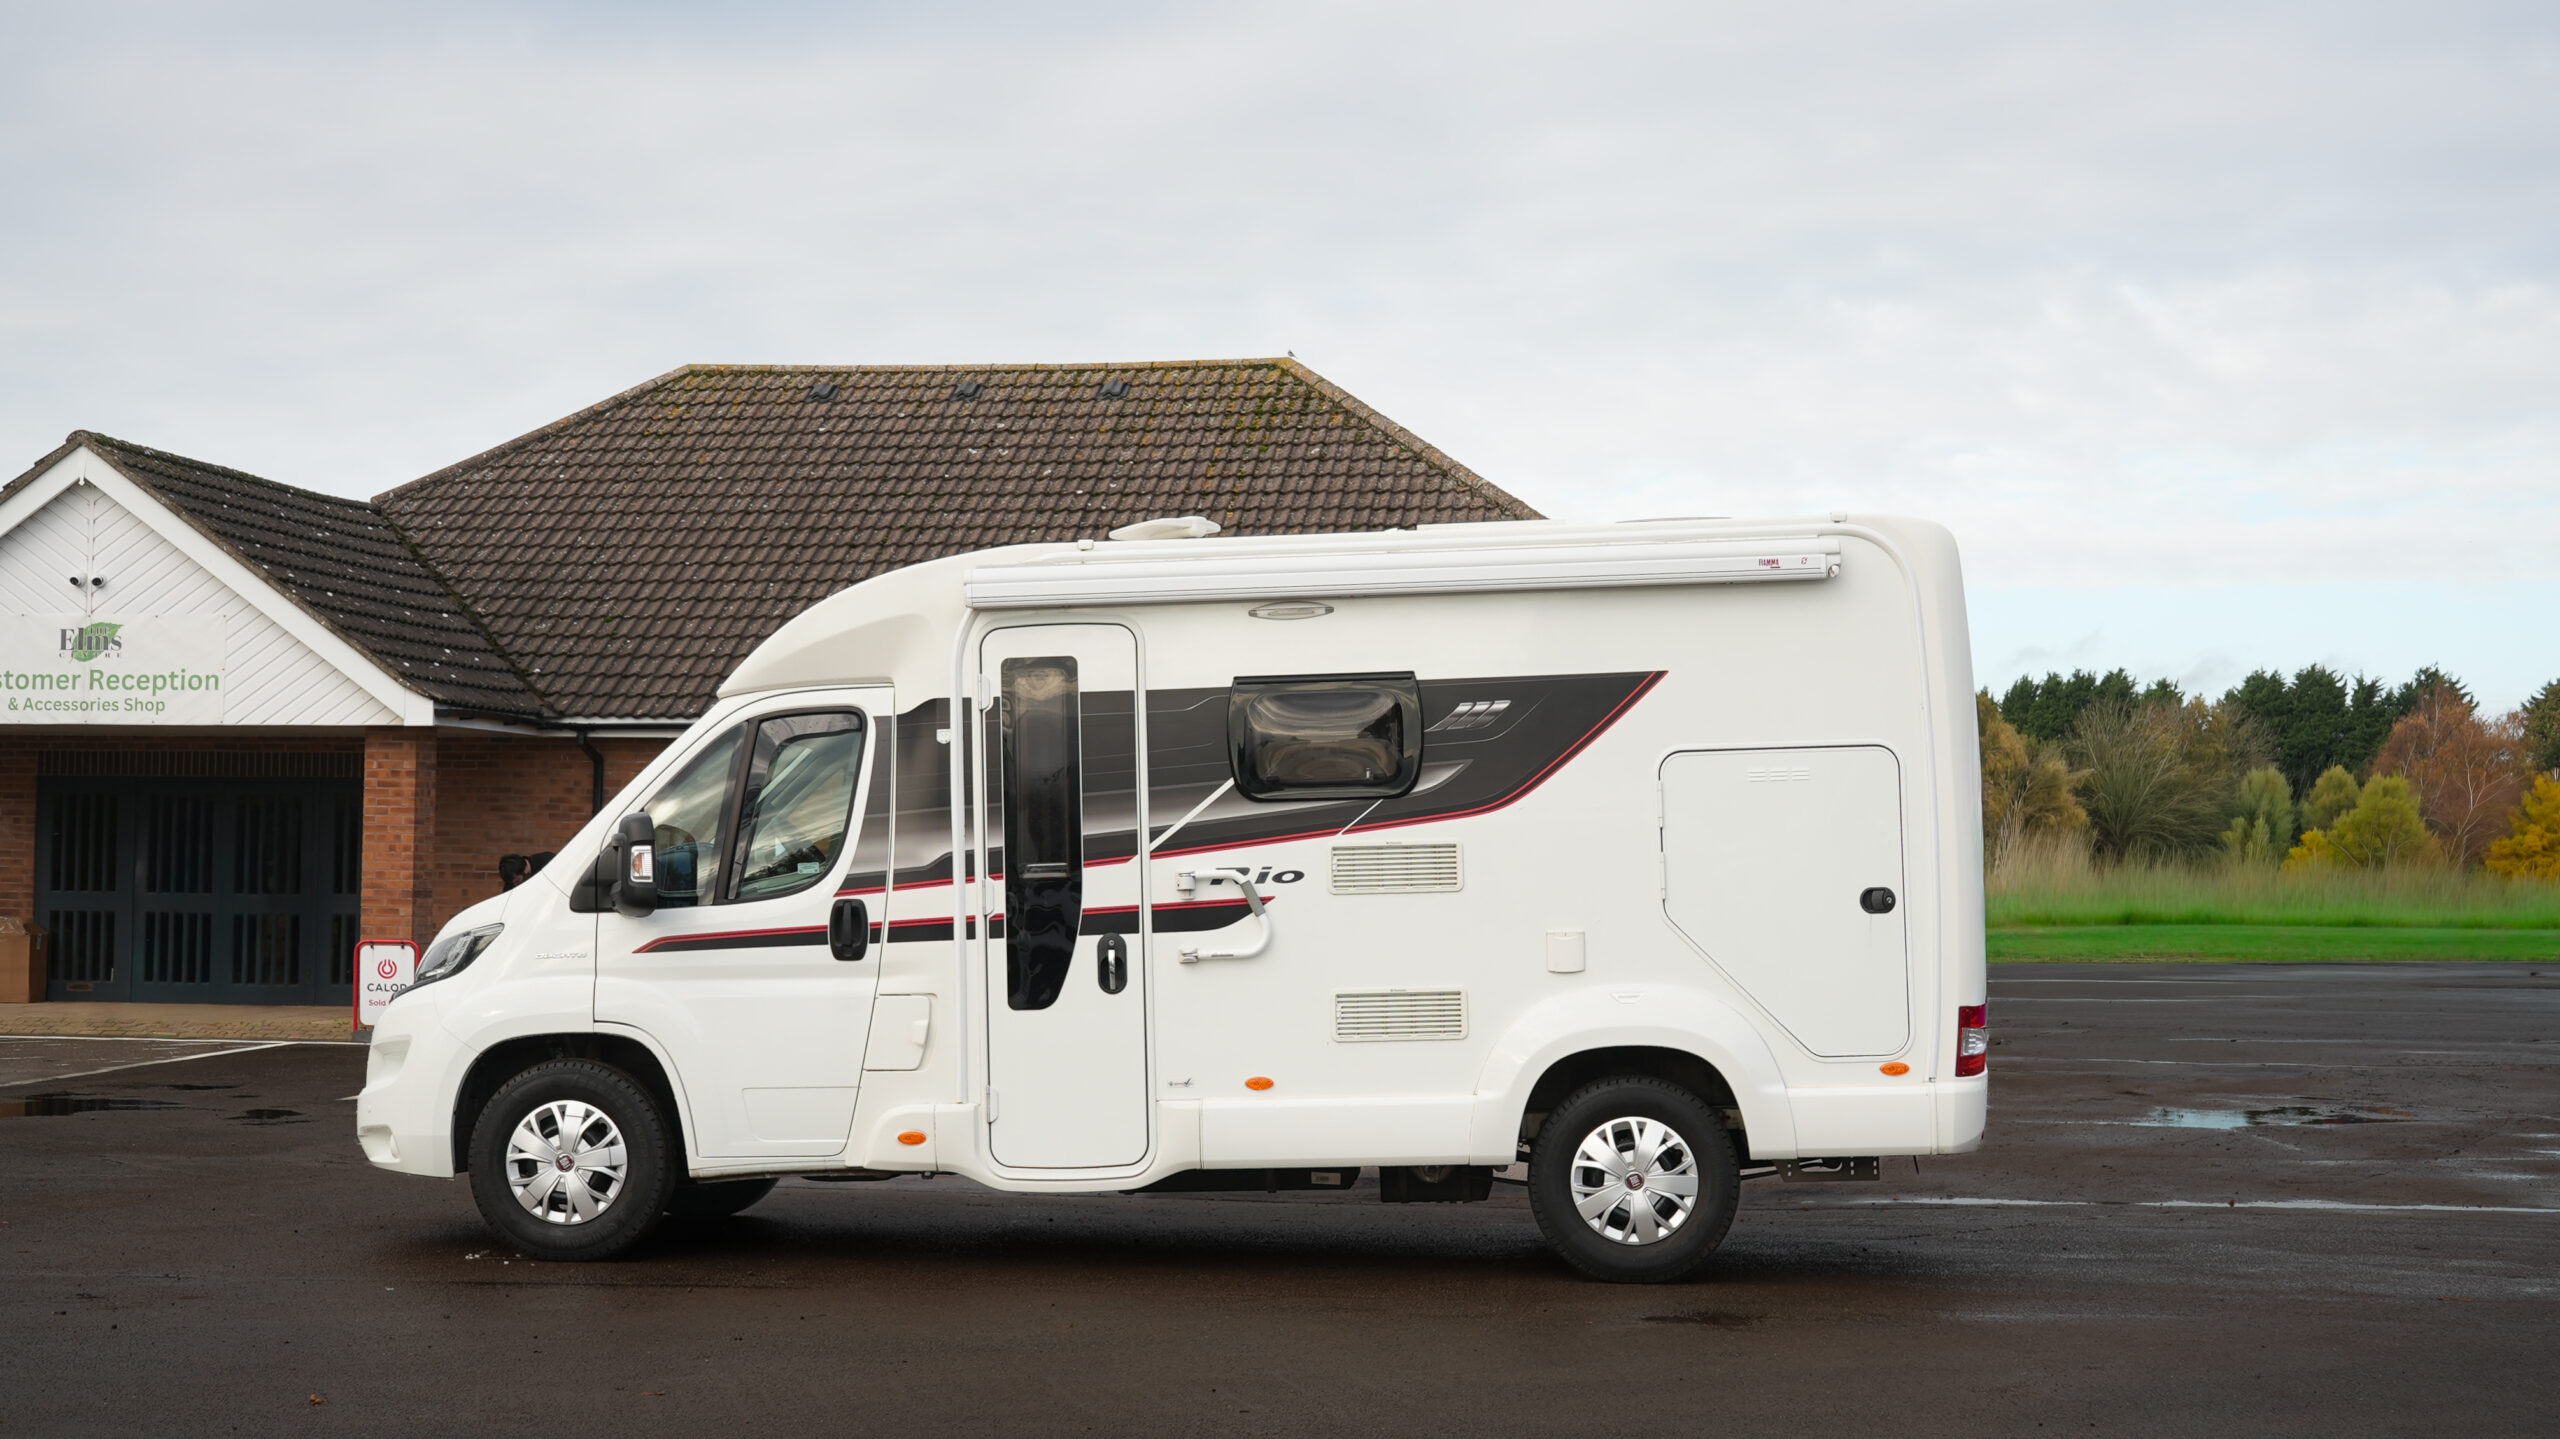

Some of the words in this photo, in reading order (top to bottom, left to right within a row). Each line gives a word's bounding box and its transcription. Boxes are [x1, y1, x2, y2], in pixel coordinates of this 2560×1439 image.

[59, 627, 122, 651] Elms
[0, 670, 81, 690] tomer
[89, 668, 219, 696] Reception
[8, 697, 18, 711] &
[23, 697, 119, 711] Accessories
[124, 697, 165, 715] Shop
